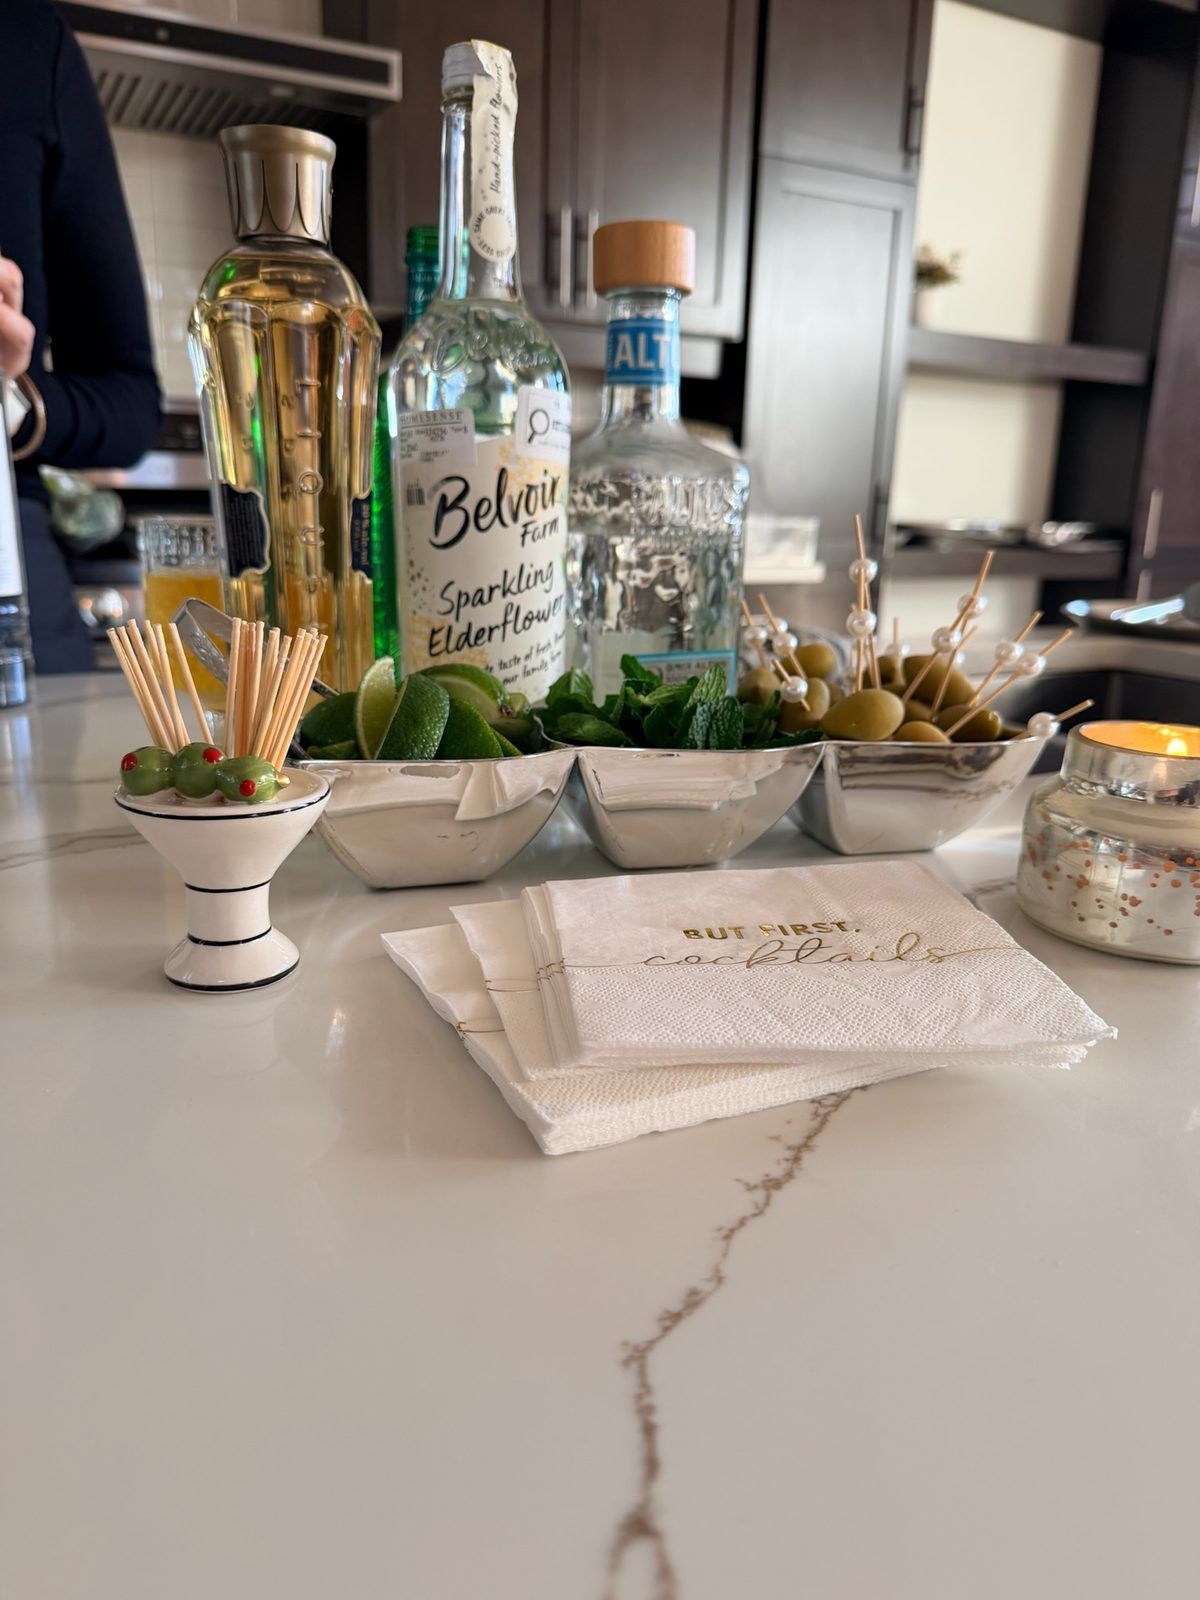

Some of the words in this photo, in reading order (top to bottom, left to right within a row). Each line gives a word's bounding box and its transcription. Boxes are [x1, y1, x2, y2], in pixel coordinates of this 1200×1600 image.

[489, 115, 502, 194] Hand-picked
[472, 211, 486, 233] SAME
[613, 332, 677, 369] ALT
[427, 467, 560, 549] Belvoir
[520, 516, 559, 548] Farm
[437, 561, 555, 622] Sparkling
[428, 594, 565, 658] Elderflower
[498, 654, 522, 671] taste
[642, 931, 952, 969] cocktails
[682, 926, 745, 940] BUT
